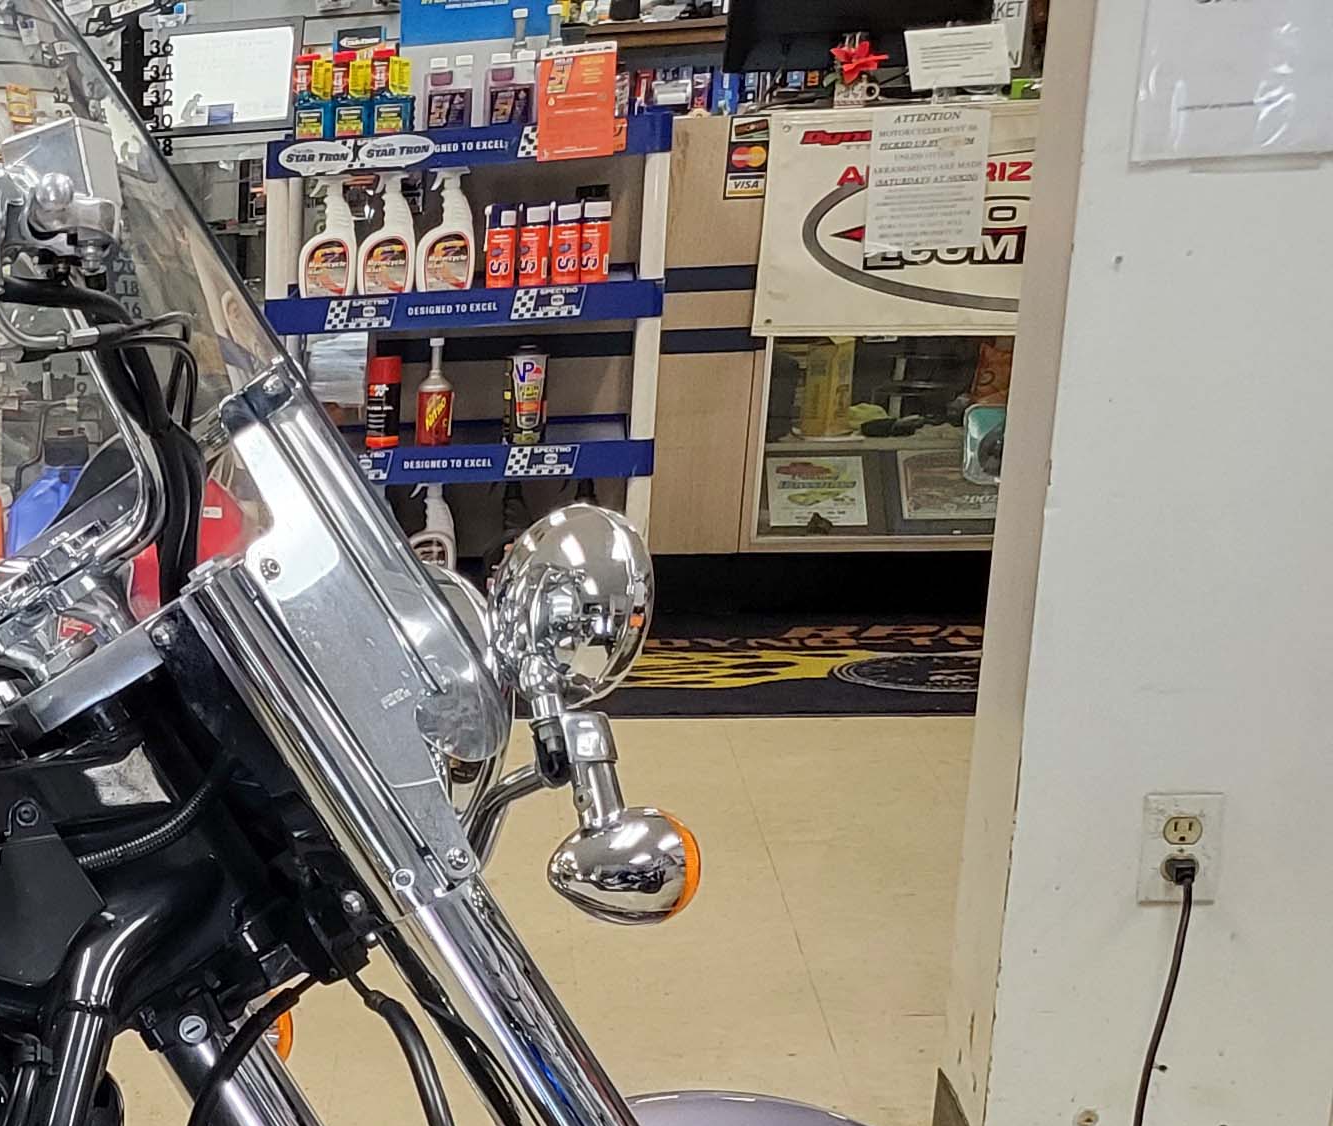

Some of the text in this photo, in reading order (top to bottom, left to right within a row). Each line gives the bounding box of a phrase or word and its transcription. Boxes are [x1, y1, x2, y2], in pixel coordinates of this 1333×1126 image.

[150, 40, 173, 55] 36
[150, 65, 173, 80] 34
[150, 90, 173, 106] 32
[151, 114, 173, 129] 30
[894, 111, 961, 124] ATTENTION
[366, 145, 429, 158] STAR TRON
[461, 141, 474, 151] TO
[476, 139, 504, 150] EXCEL
[286, 152, 348, 163] STAR TRON
[733, 181, 759, 189] VISA
[540, 287, 579, 296] SPECTRO
[351, 298, 389, 307] SPECTRO
[407, 302, 498, 316] DESIGNED TO EXCEL
[515, 361, 535, 383] VP
[533, 446, 571, 454] SPECTRO
[404, 458, 492, 469] DESIGNED TO EXCEL
